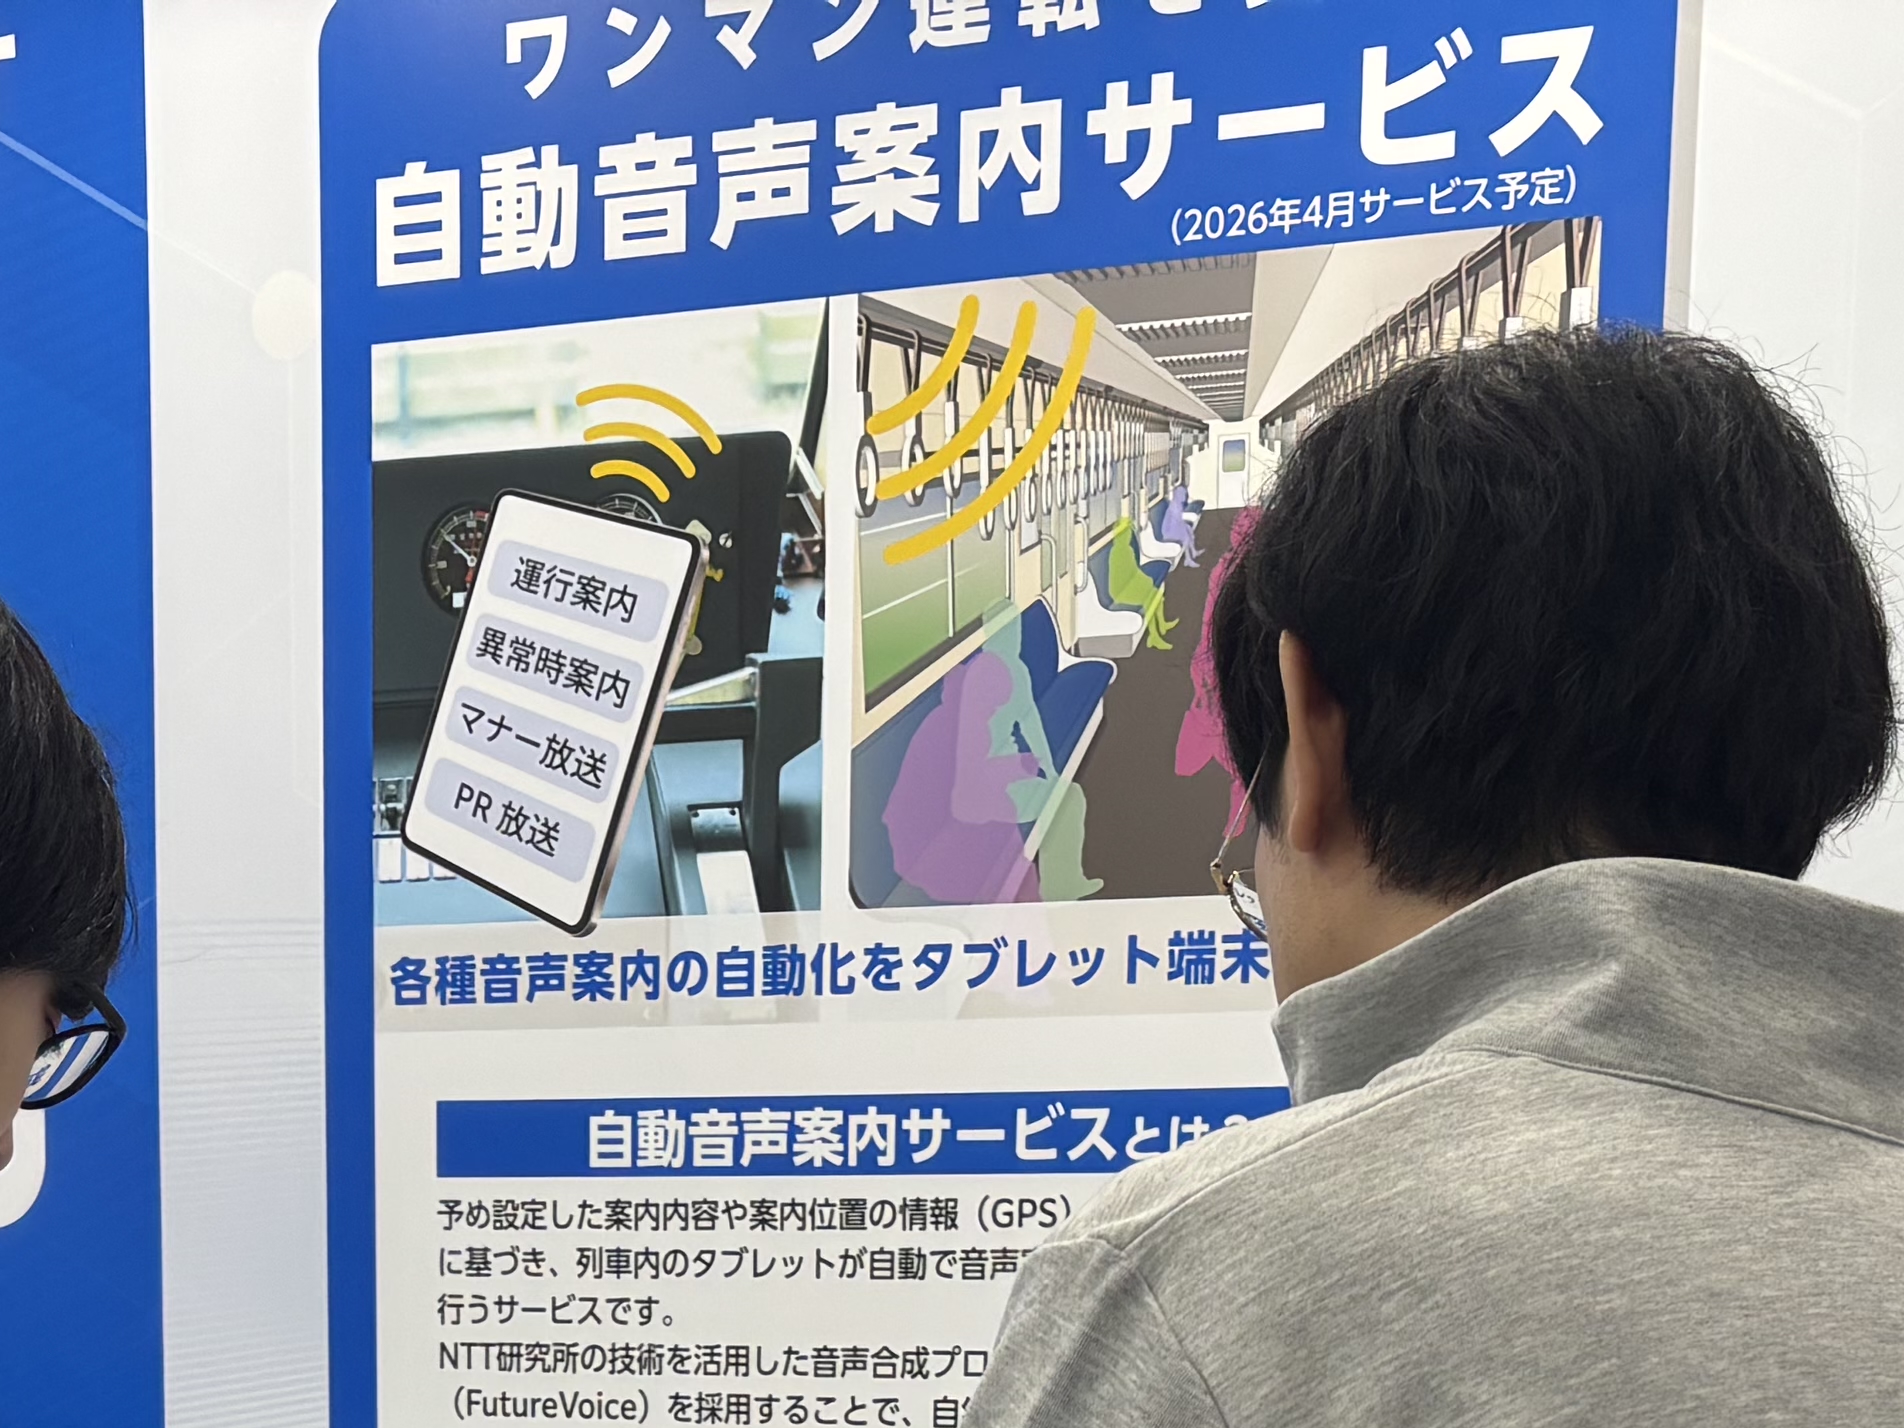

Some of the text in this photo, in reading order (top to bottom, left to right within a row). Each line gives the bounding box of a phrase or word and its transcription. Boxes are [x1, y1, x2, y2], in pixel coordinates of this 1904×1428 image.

[374, 23, 1607, 288] 自動音声案内サービス
[509, 555, 639, 625] 運行案内
[474, 626, 632, 710] 異常時案内
[460, 702, 607, 789] マナー放送
[453, 781, 561, 858] PR 放送
[390, 927, 1271, 1006] 各種音声案内の自動化をタブレット端末
[437, 1294, 676, 1327] 行うサービスです。
